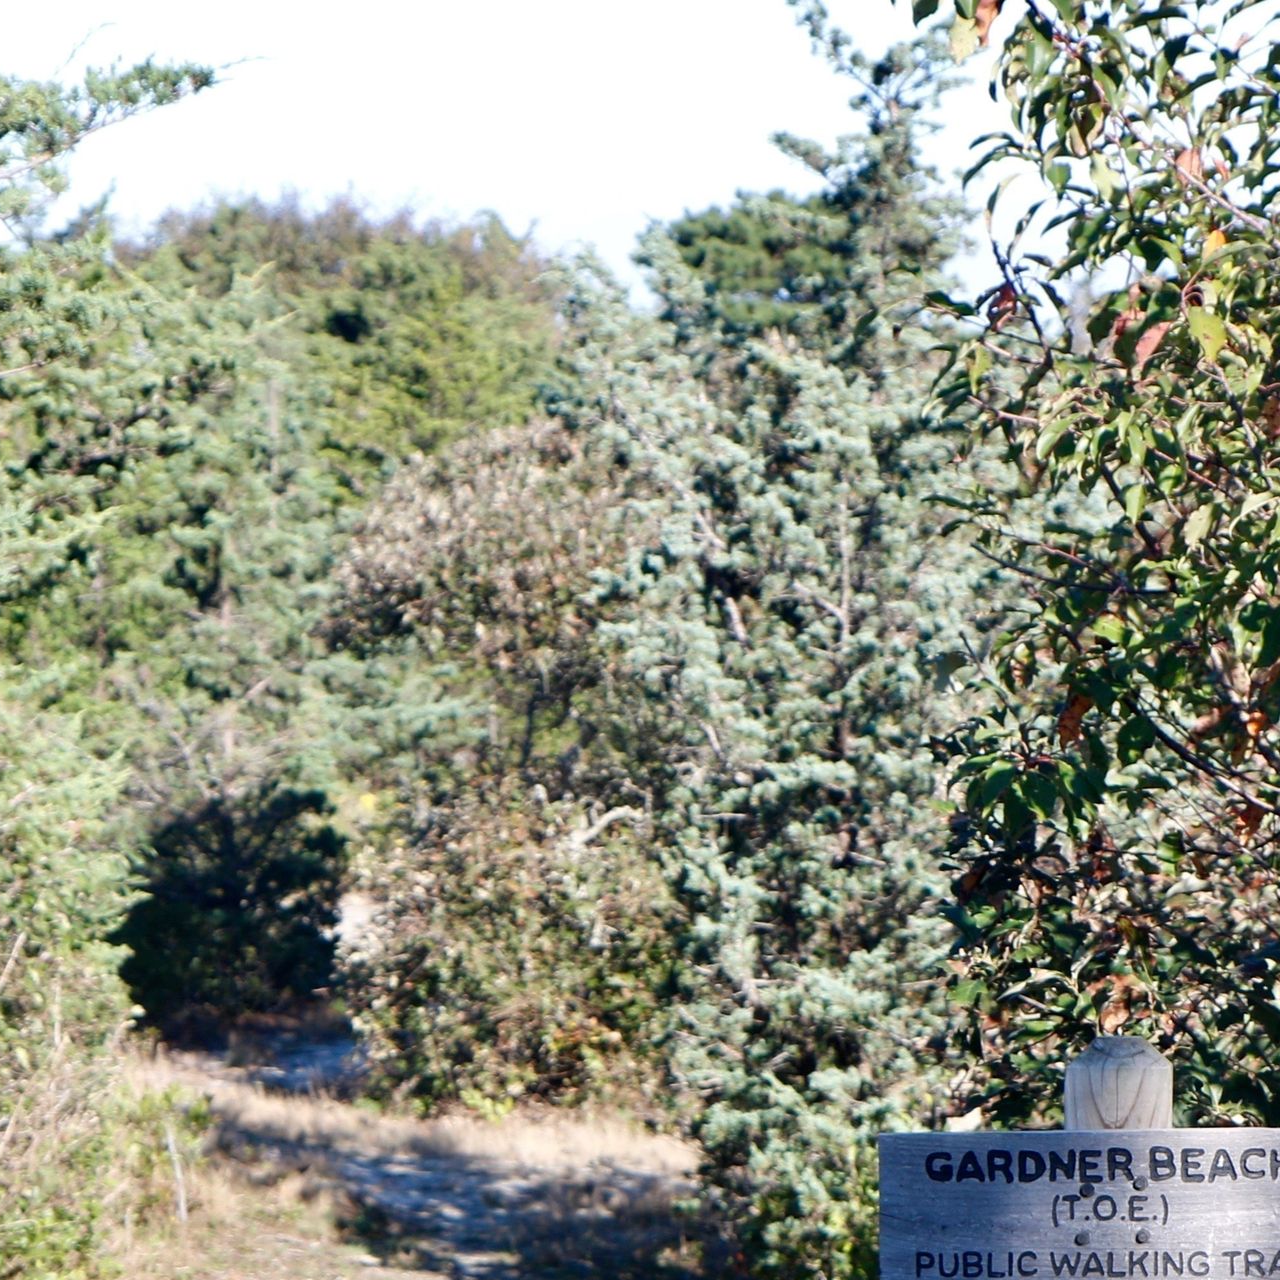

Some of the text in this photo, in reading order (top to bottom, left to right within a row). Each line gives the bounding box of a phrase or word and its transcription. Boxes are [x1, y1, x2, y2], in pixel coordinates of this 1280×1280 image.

[925, 1148, 1134, 1184] GARDNER
[1051, 1193, 1169, 1227] (T.O.E.)
[915, 1250, 1038, 1278] PUBLIC
[1050, 1250, 1211, 1278] WALKING
